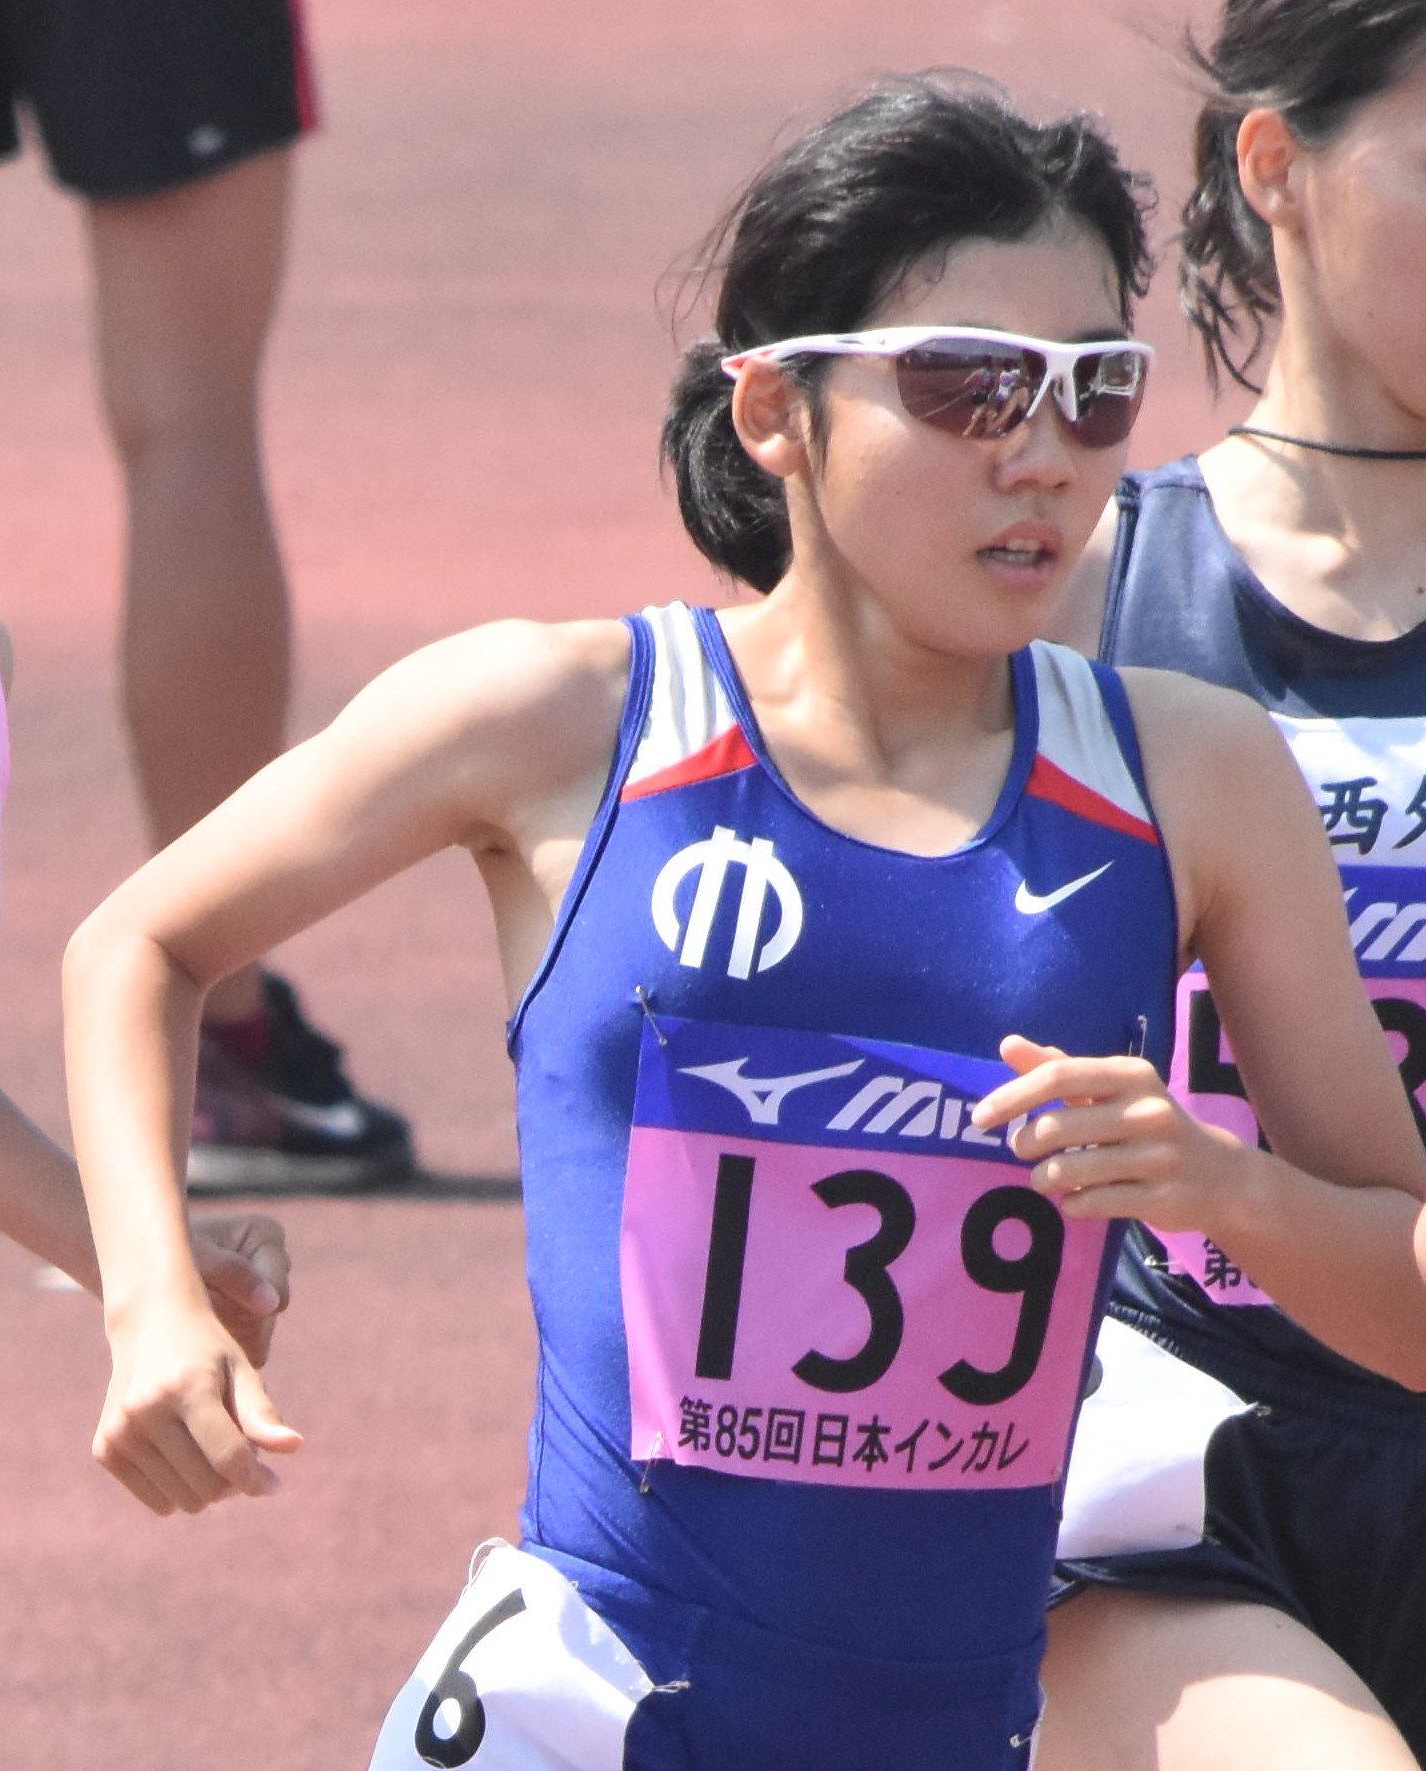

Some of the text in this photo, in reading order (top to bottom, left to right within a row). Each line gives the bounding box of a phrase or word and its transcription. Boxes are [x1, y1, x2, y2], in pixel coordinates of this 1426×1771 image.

[825, 1074, 1099, 1152] MIZ
[692, 1152, 1065, 1407] 139
[677, 1395, 1030, 1474] 第85回日本インカレ
[414, 1587, 527, 1770] 6
